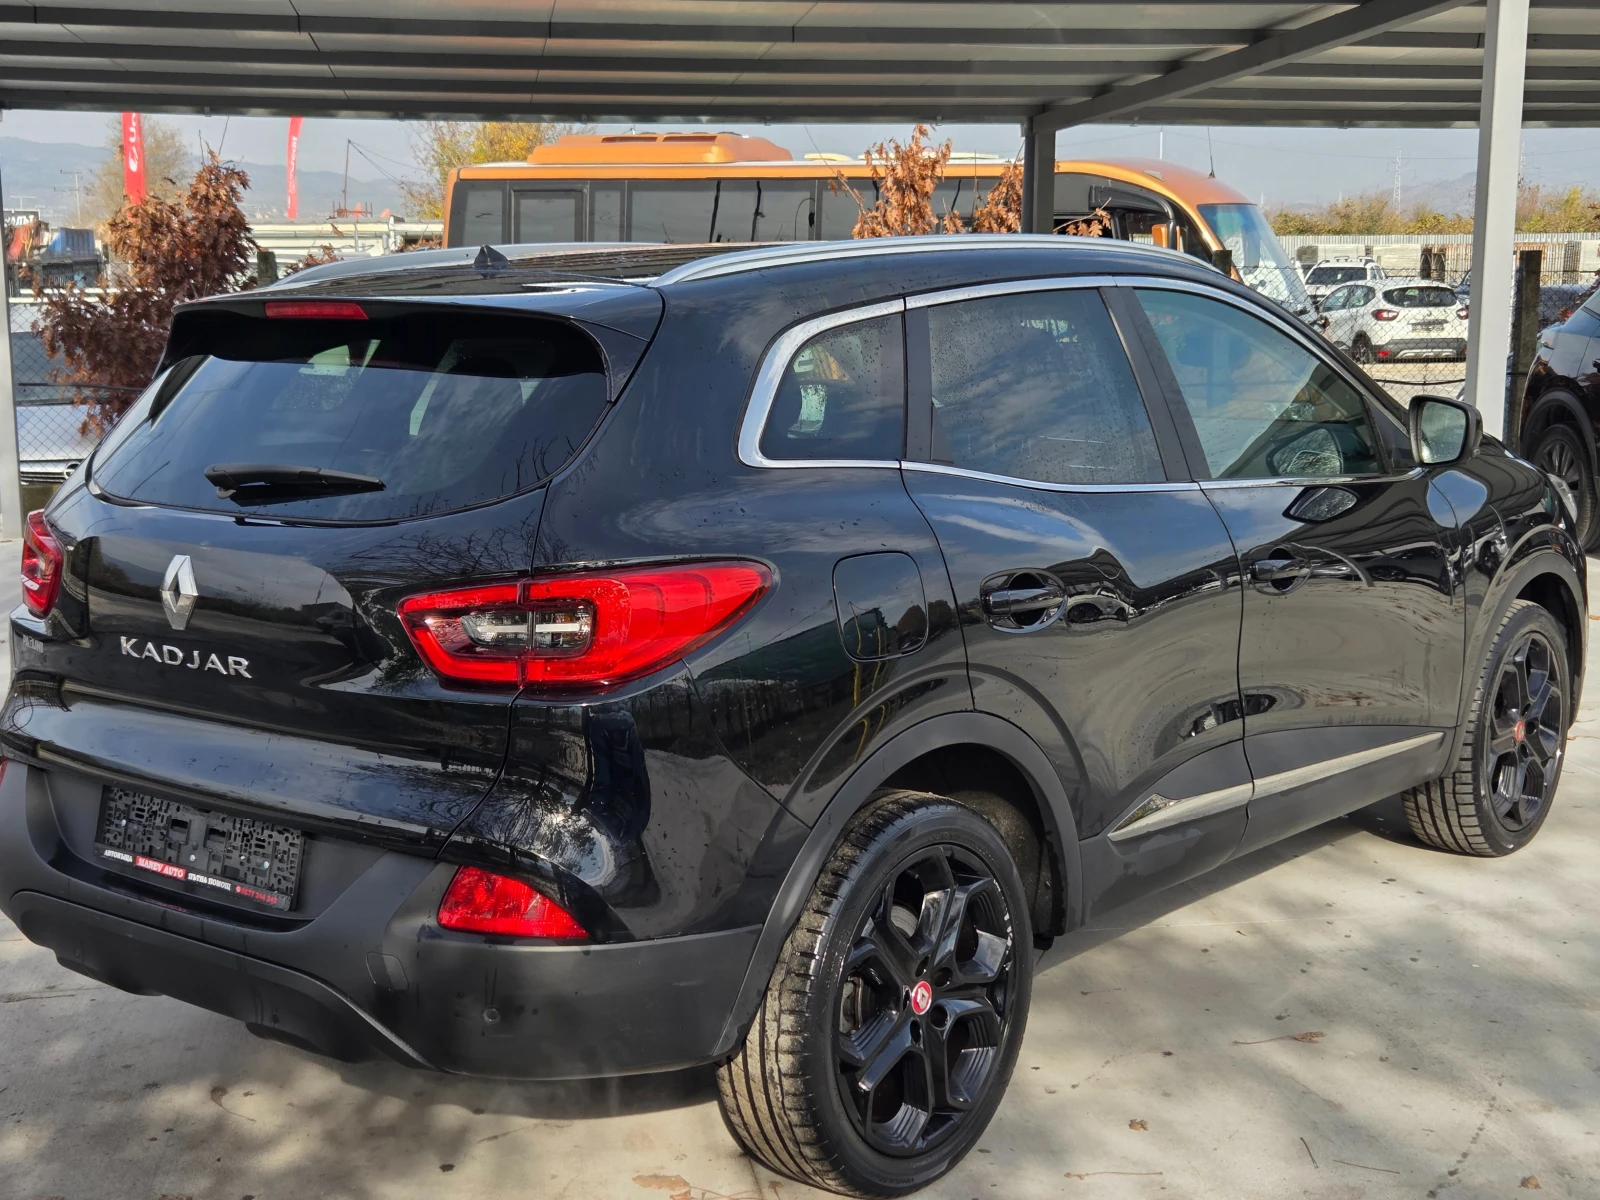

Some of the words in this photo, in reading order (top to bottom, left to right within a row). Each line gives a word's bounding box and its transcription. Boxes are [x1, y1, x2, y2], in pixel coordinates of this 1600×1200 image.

[119, 636, 252, 679] KADJAR
[104, 849, 132, 863] АВТОКЪЩА
[138, 857, 162, 873] MANEV
[163, 865, 184, 878] AUTO
[188, 873, 207, 884] ПЪТНА
[208, 877, 231, 891] ПОМОЩ
